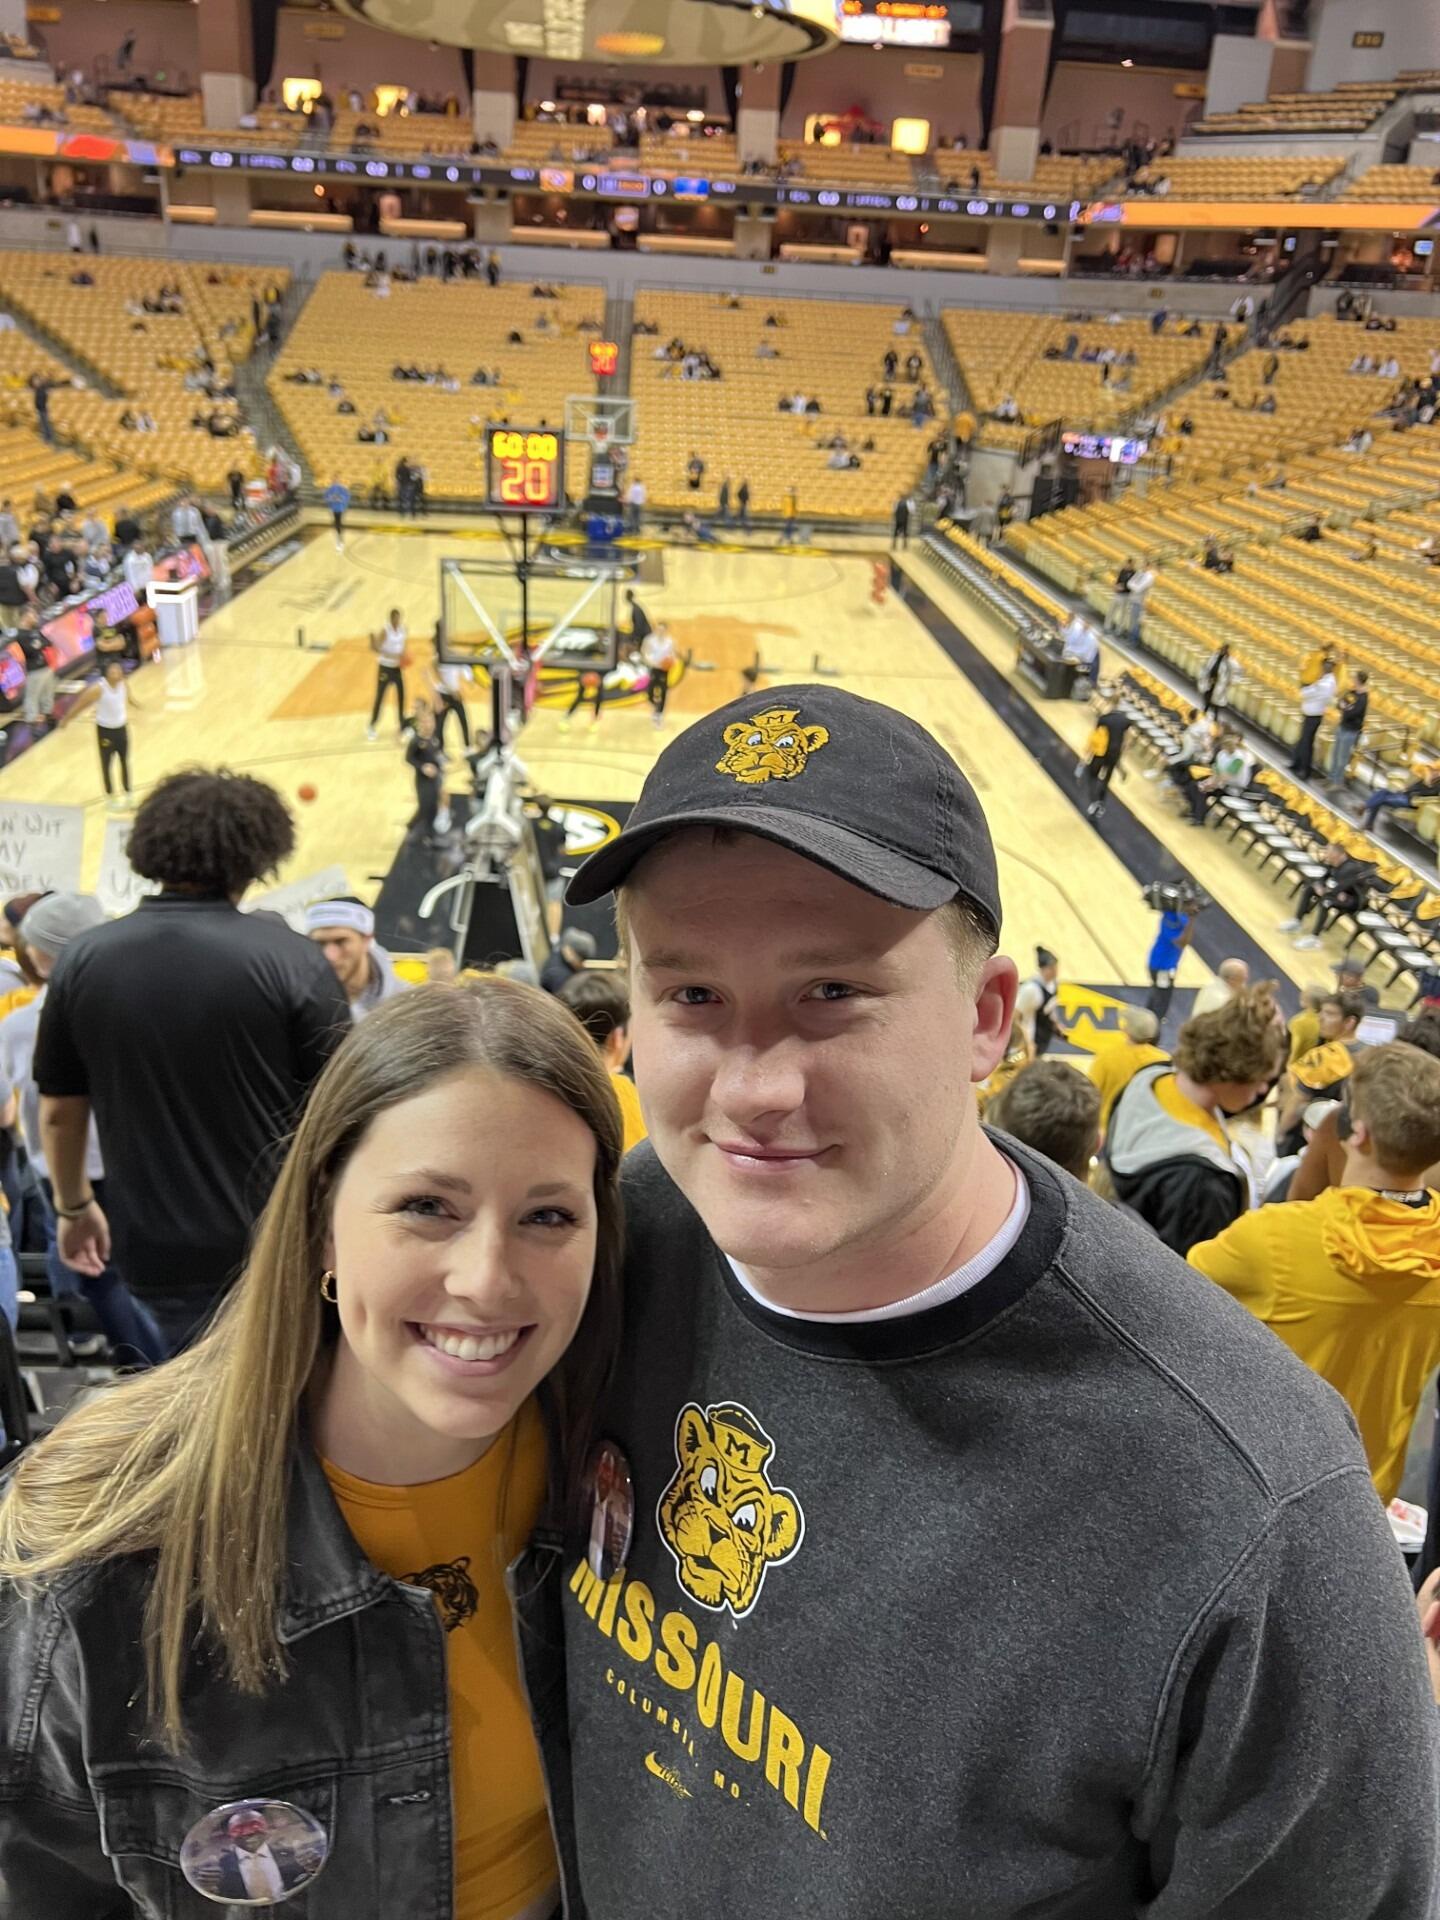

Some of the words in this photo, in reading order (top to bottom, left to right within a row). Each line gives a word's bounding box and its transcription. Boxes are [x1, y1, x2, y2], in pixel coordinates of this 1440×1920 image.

[501, 460, 549, 504] 20
[765, 714, 785, 725] M
[24, 813, 65, 837] WIT
[724, 1431, 751, 1467] M
[569, 1557, 832, 1833] MISSOURI
